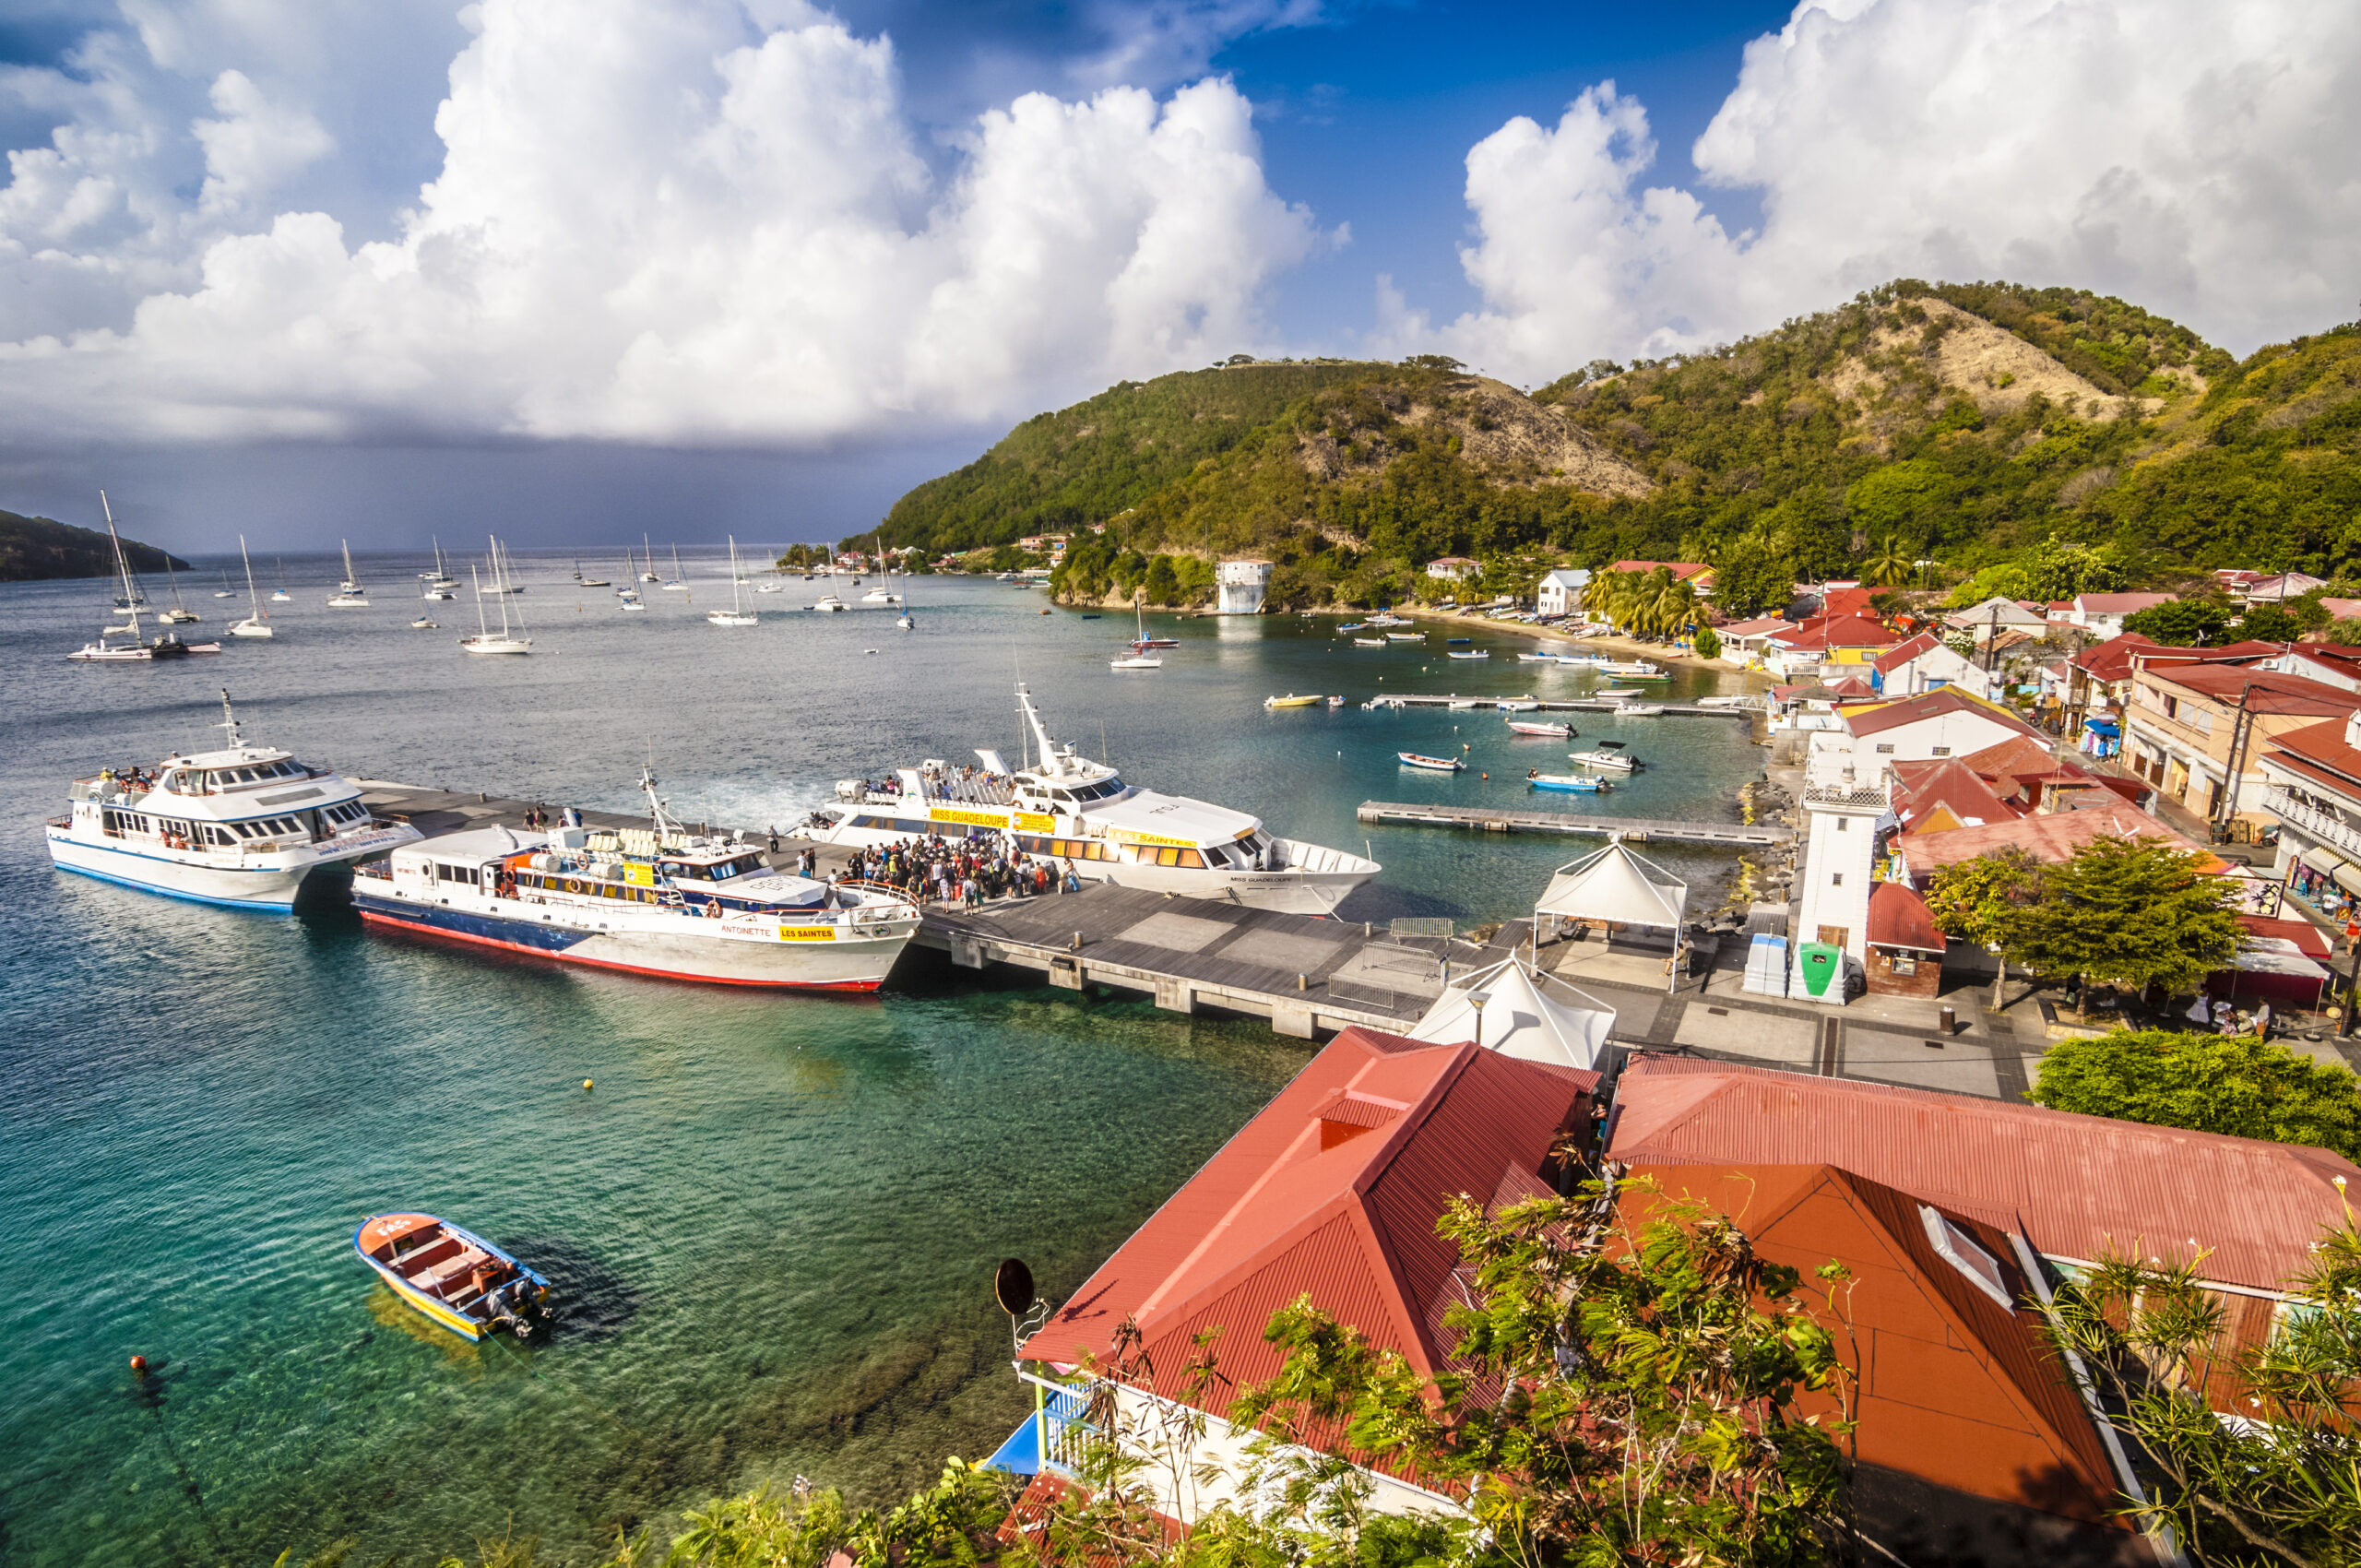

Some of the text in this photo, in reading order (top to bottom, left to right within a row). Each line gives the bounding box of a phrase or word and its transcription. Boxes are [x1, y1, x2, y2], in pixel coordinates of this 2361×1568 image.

[931, 809, 950, 820] MISS
[951, 812, 1008, 827] GUADELOUPE
[1139, 835, 1192, 846] SAINTES
[720, 925, 772, 937] ANTOINETTE
[781, 929, 833, 938] LES SAINTES
